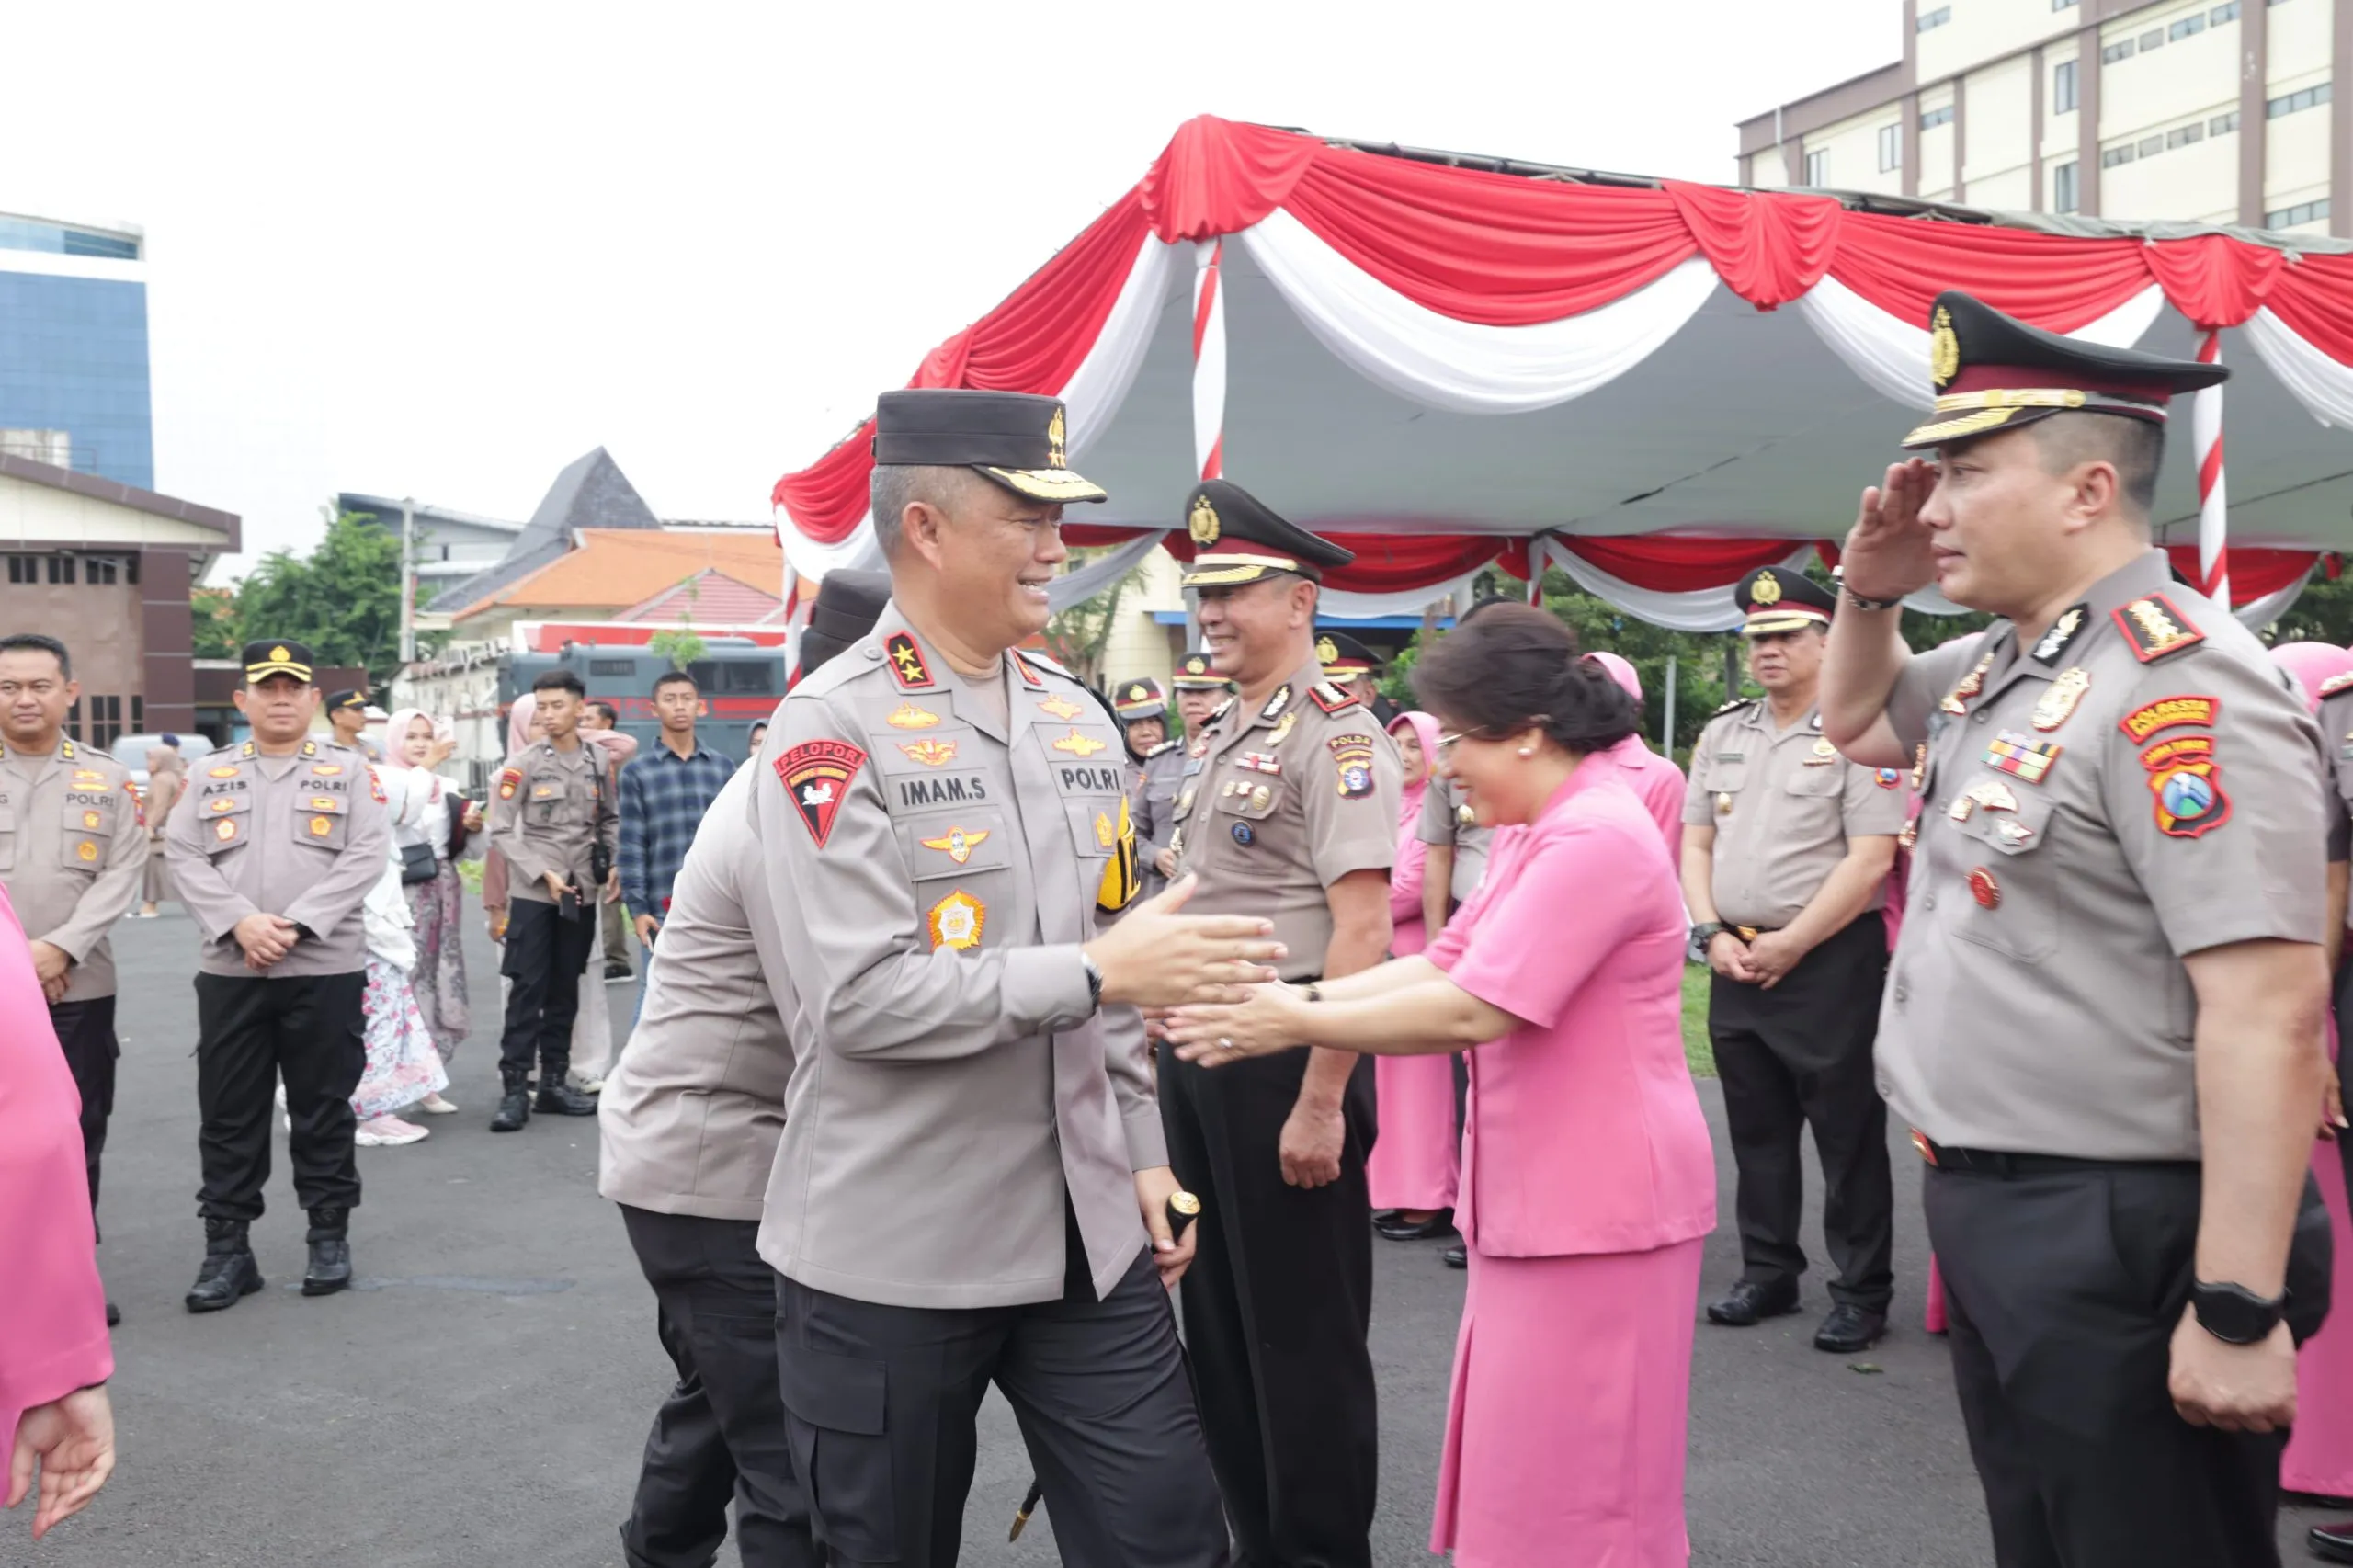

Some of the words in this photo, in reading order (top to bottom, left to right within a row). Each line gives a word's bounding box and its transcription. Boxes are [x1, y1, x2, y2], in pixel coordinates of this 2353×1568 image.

[780, 742, 858, 769] PELOPOR
[202, 780, 246, 797] AZIS
[300, 779, 347, 791] POLRI
[1061, 768, 1120, 790] POLRI
[66, 793, 114, 807] POLRI
[900, 777, 987, 806] IMAM.S
